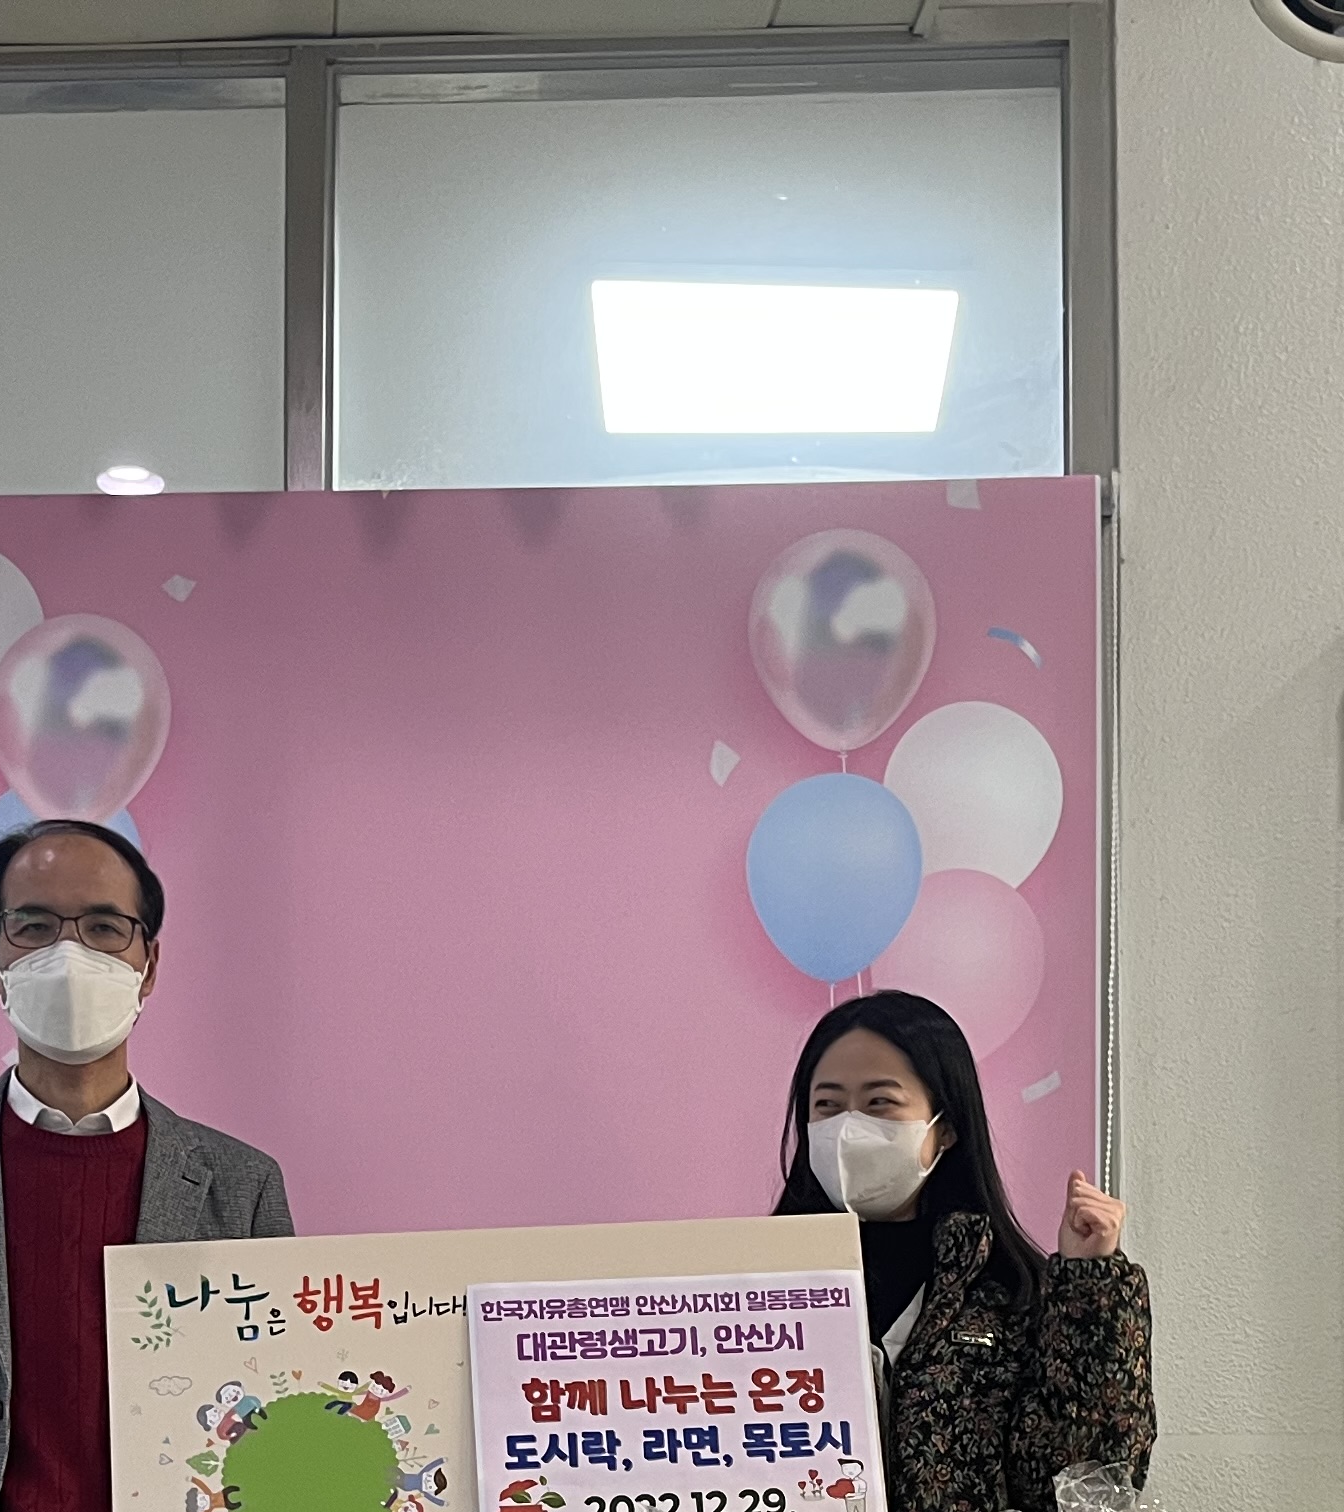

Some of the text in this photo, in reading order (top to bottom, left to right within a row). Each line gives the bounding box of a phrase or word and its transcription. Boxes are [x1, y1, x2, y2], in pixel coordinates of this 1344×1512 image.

[164, 1272, 467, 1341] 나눔은 행복입니다!
[481, 1286, 851, 1322] 한국자유총연맹 안산시지회 일동동분회
[517, 1322, 805, 1361] 대관령생고기, 안산시
[521, 1367, 826, 1424] 함께 나누는 온정
[505, 1420, 852, 1472] 도시락, 라면, 목토시
